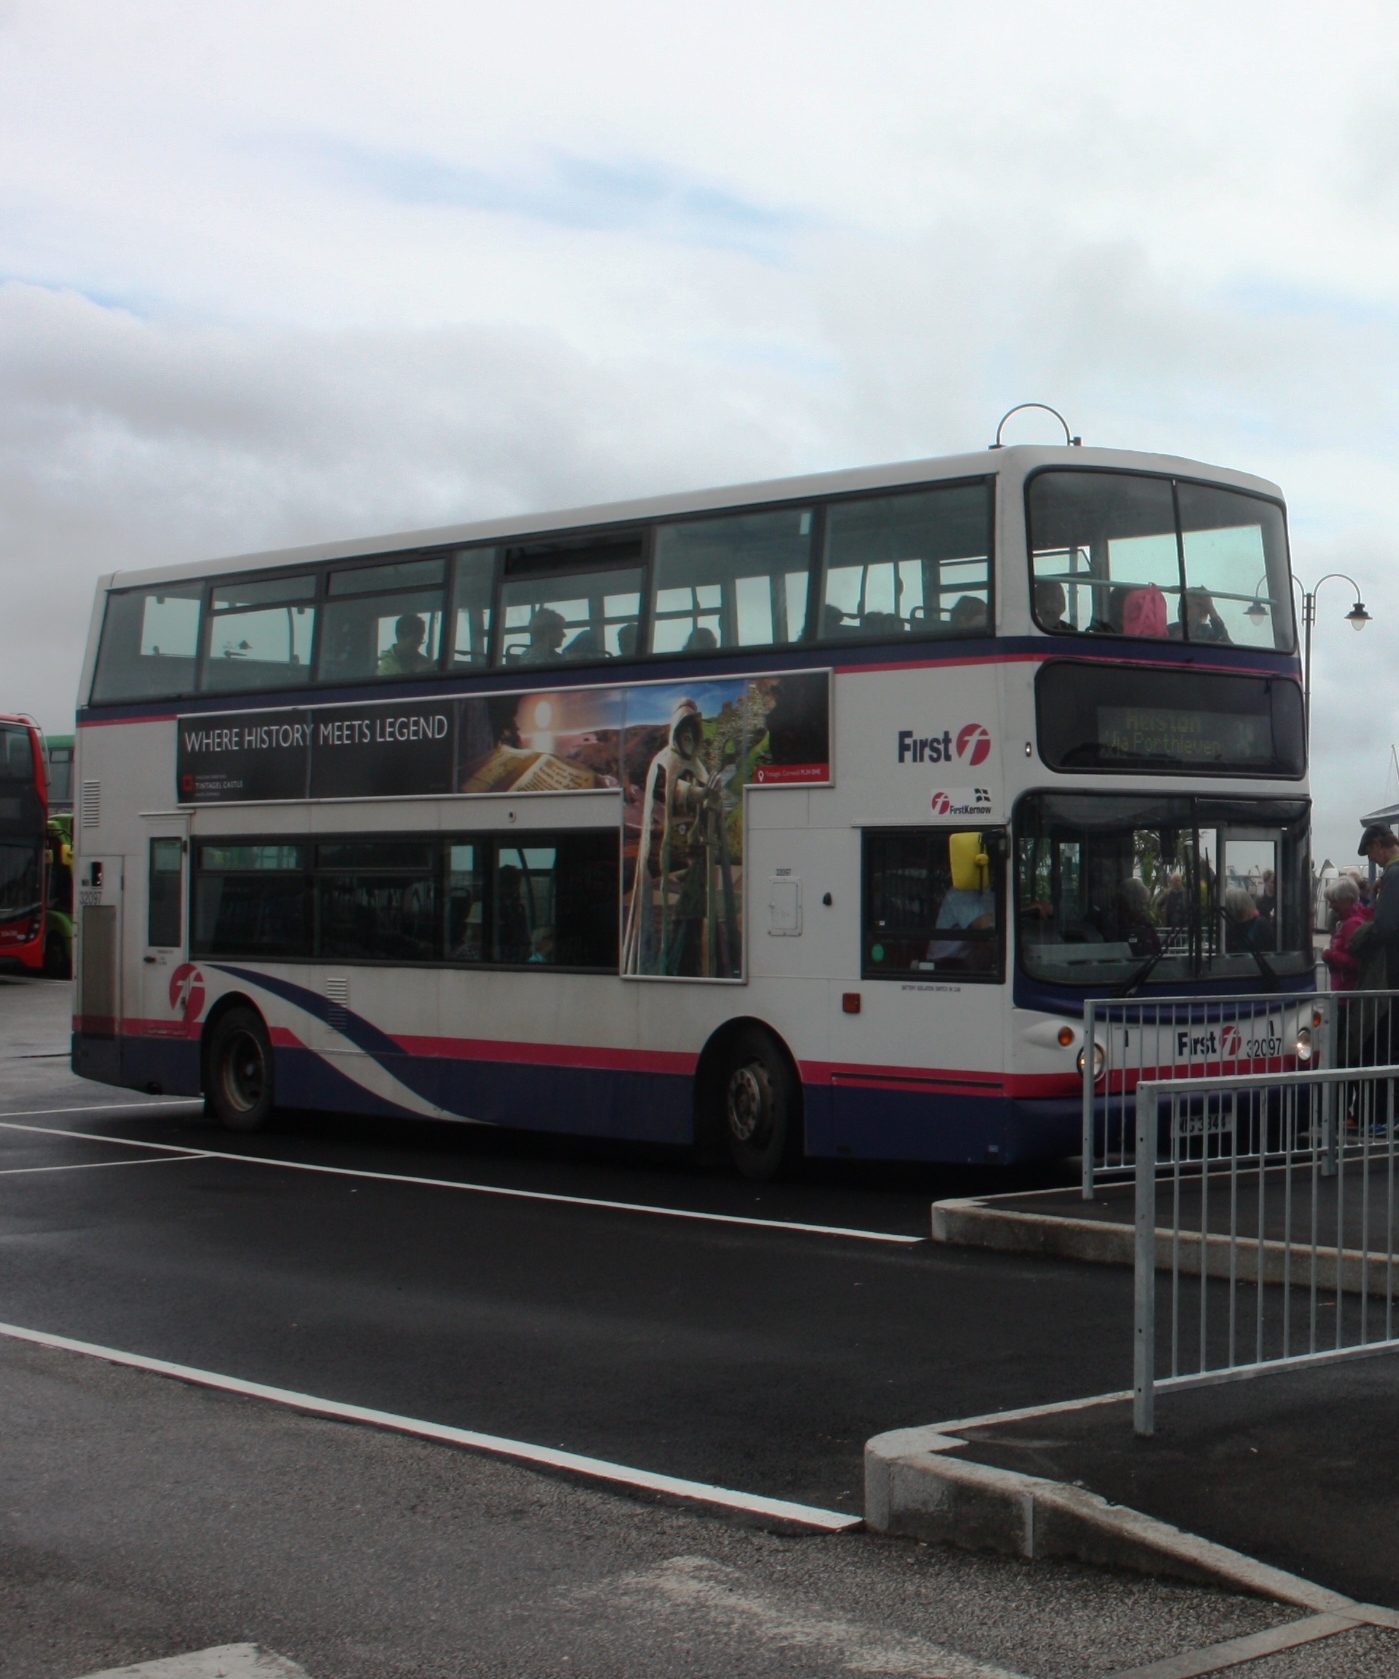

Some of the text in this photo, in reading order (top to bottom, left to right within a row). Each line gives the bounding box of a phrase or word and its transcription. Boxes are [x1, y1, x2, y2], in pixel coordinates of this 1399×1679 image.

[185, 715, 448, 752] WHERE HISTORY MEETS LEGEND
[898, 730, 952, 763] First
[223, 780, 243, 789] CASTLE
[79, 891, 102, 905] 32097
[1177, 1031, 1217, 1056] First
[1246, 1037, 1282, 1058] 32097
